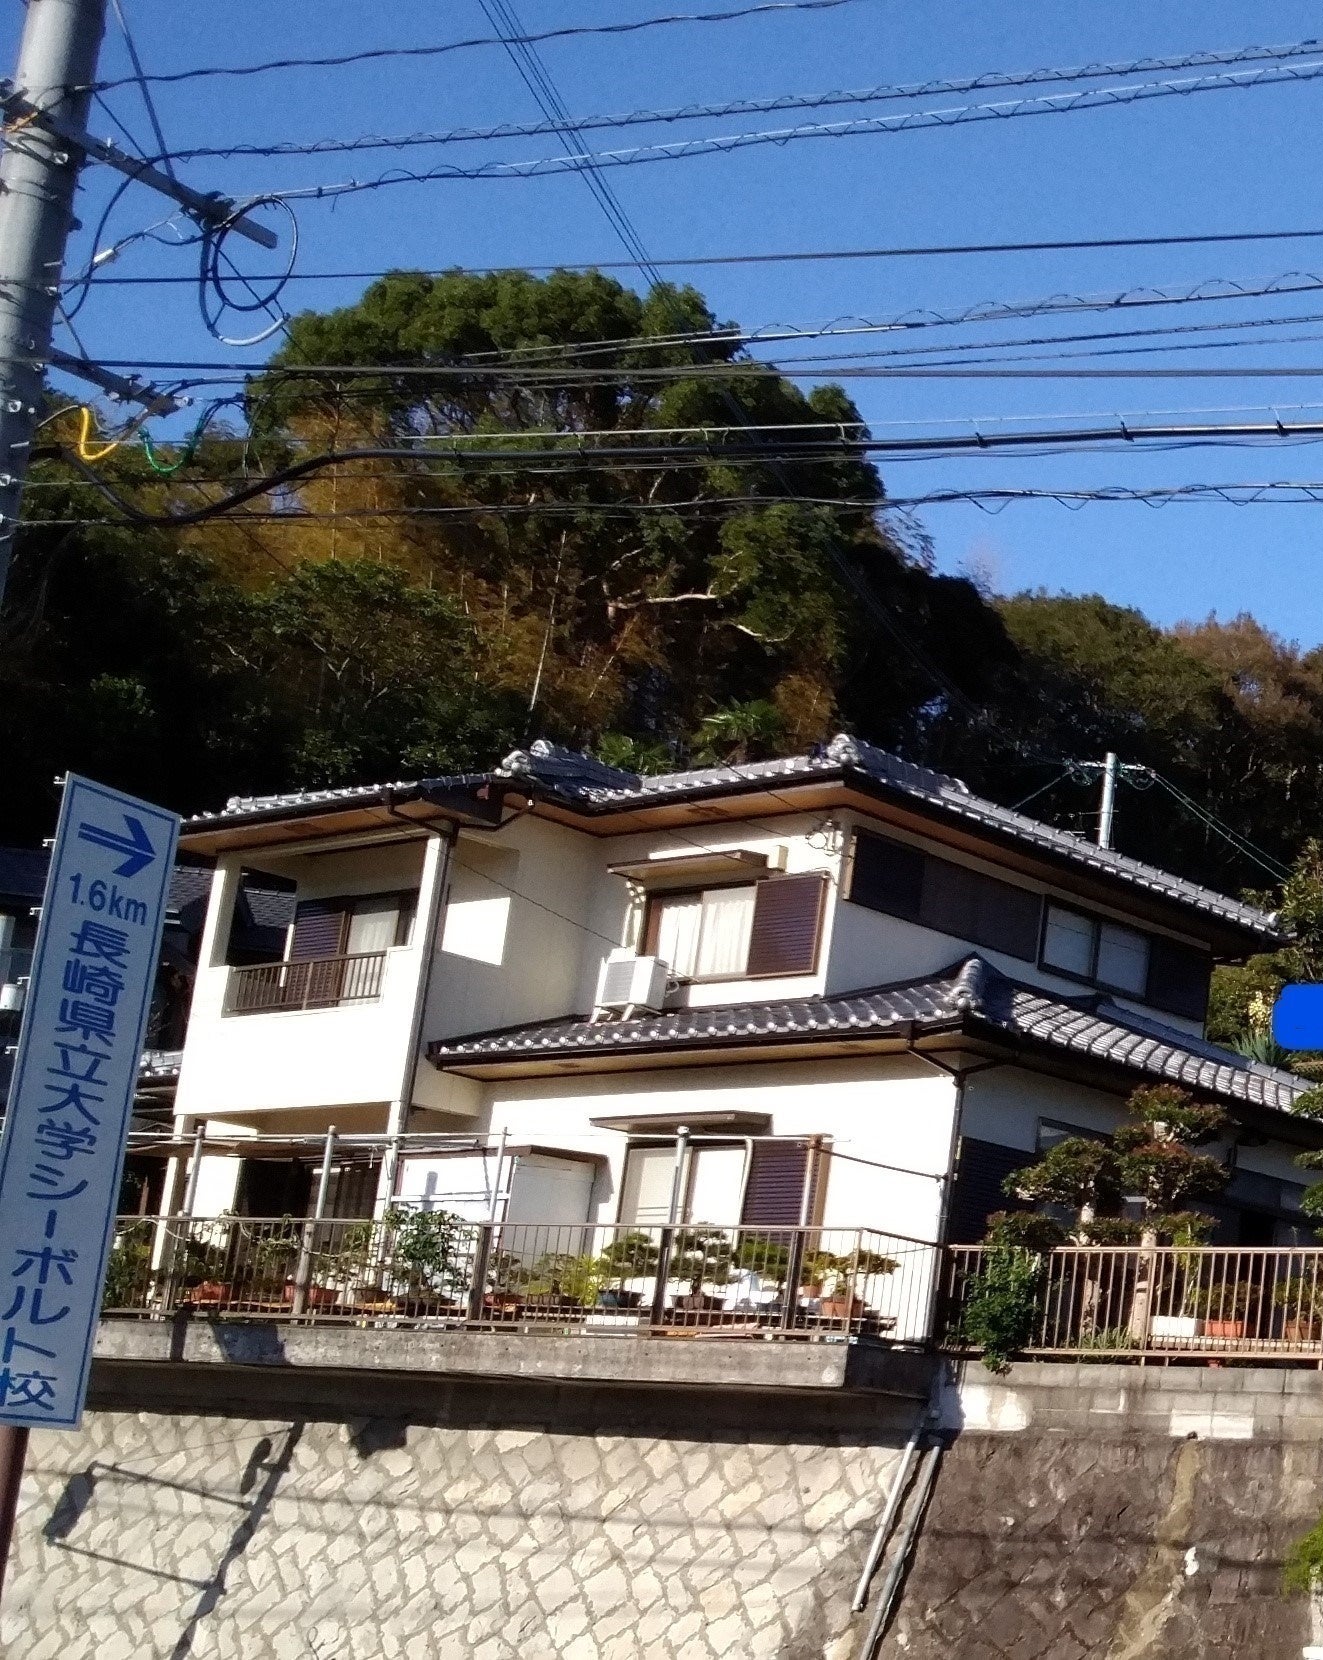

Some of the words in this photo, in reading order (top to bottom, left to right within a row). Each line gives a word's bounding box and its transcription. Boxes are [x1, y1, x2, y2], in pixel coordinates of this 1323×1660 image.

[69, 872, 149, 926] 1.6km
[0, 919, 131, 1411] 長崎県立大学シーボルト校
